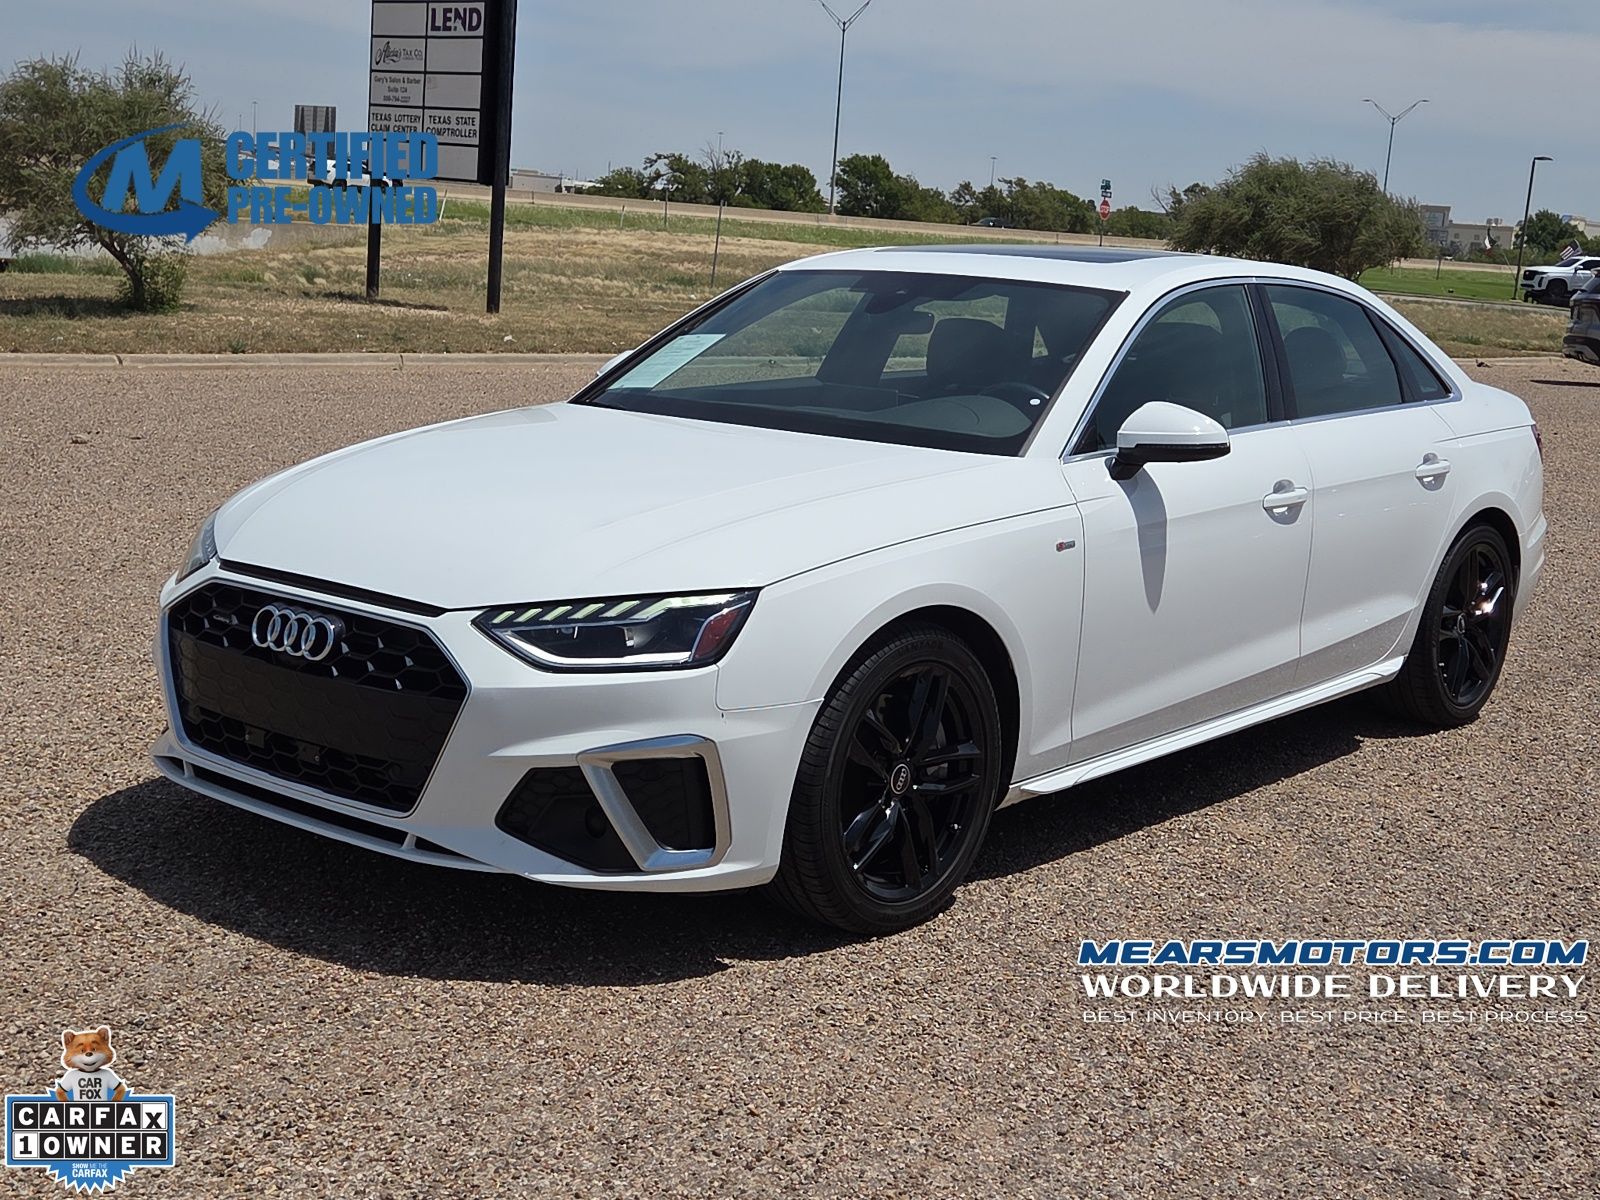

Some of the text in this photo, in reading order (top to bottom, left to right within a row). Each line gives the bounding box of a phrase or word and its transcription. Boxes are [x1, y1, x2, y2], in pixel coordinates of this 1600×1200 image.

[430, 7, 482, 32] LEND
[371, 112, 422, 124] TEXAS LOTTERY
[428, 115, 476, 127] TEXAS STATE
[371, 123, 418, 133] CLAIM CENTER
[426, 126, 478, 138] COMPTROLLER
